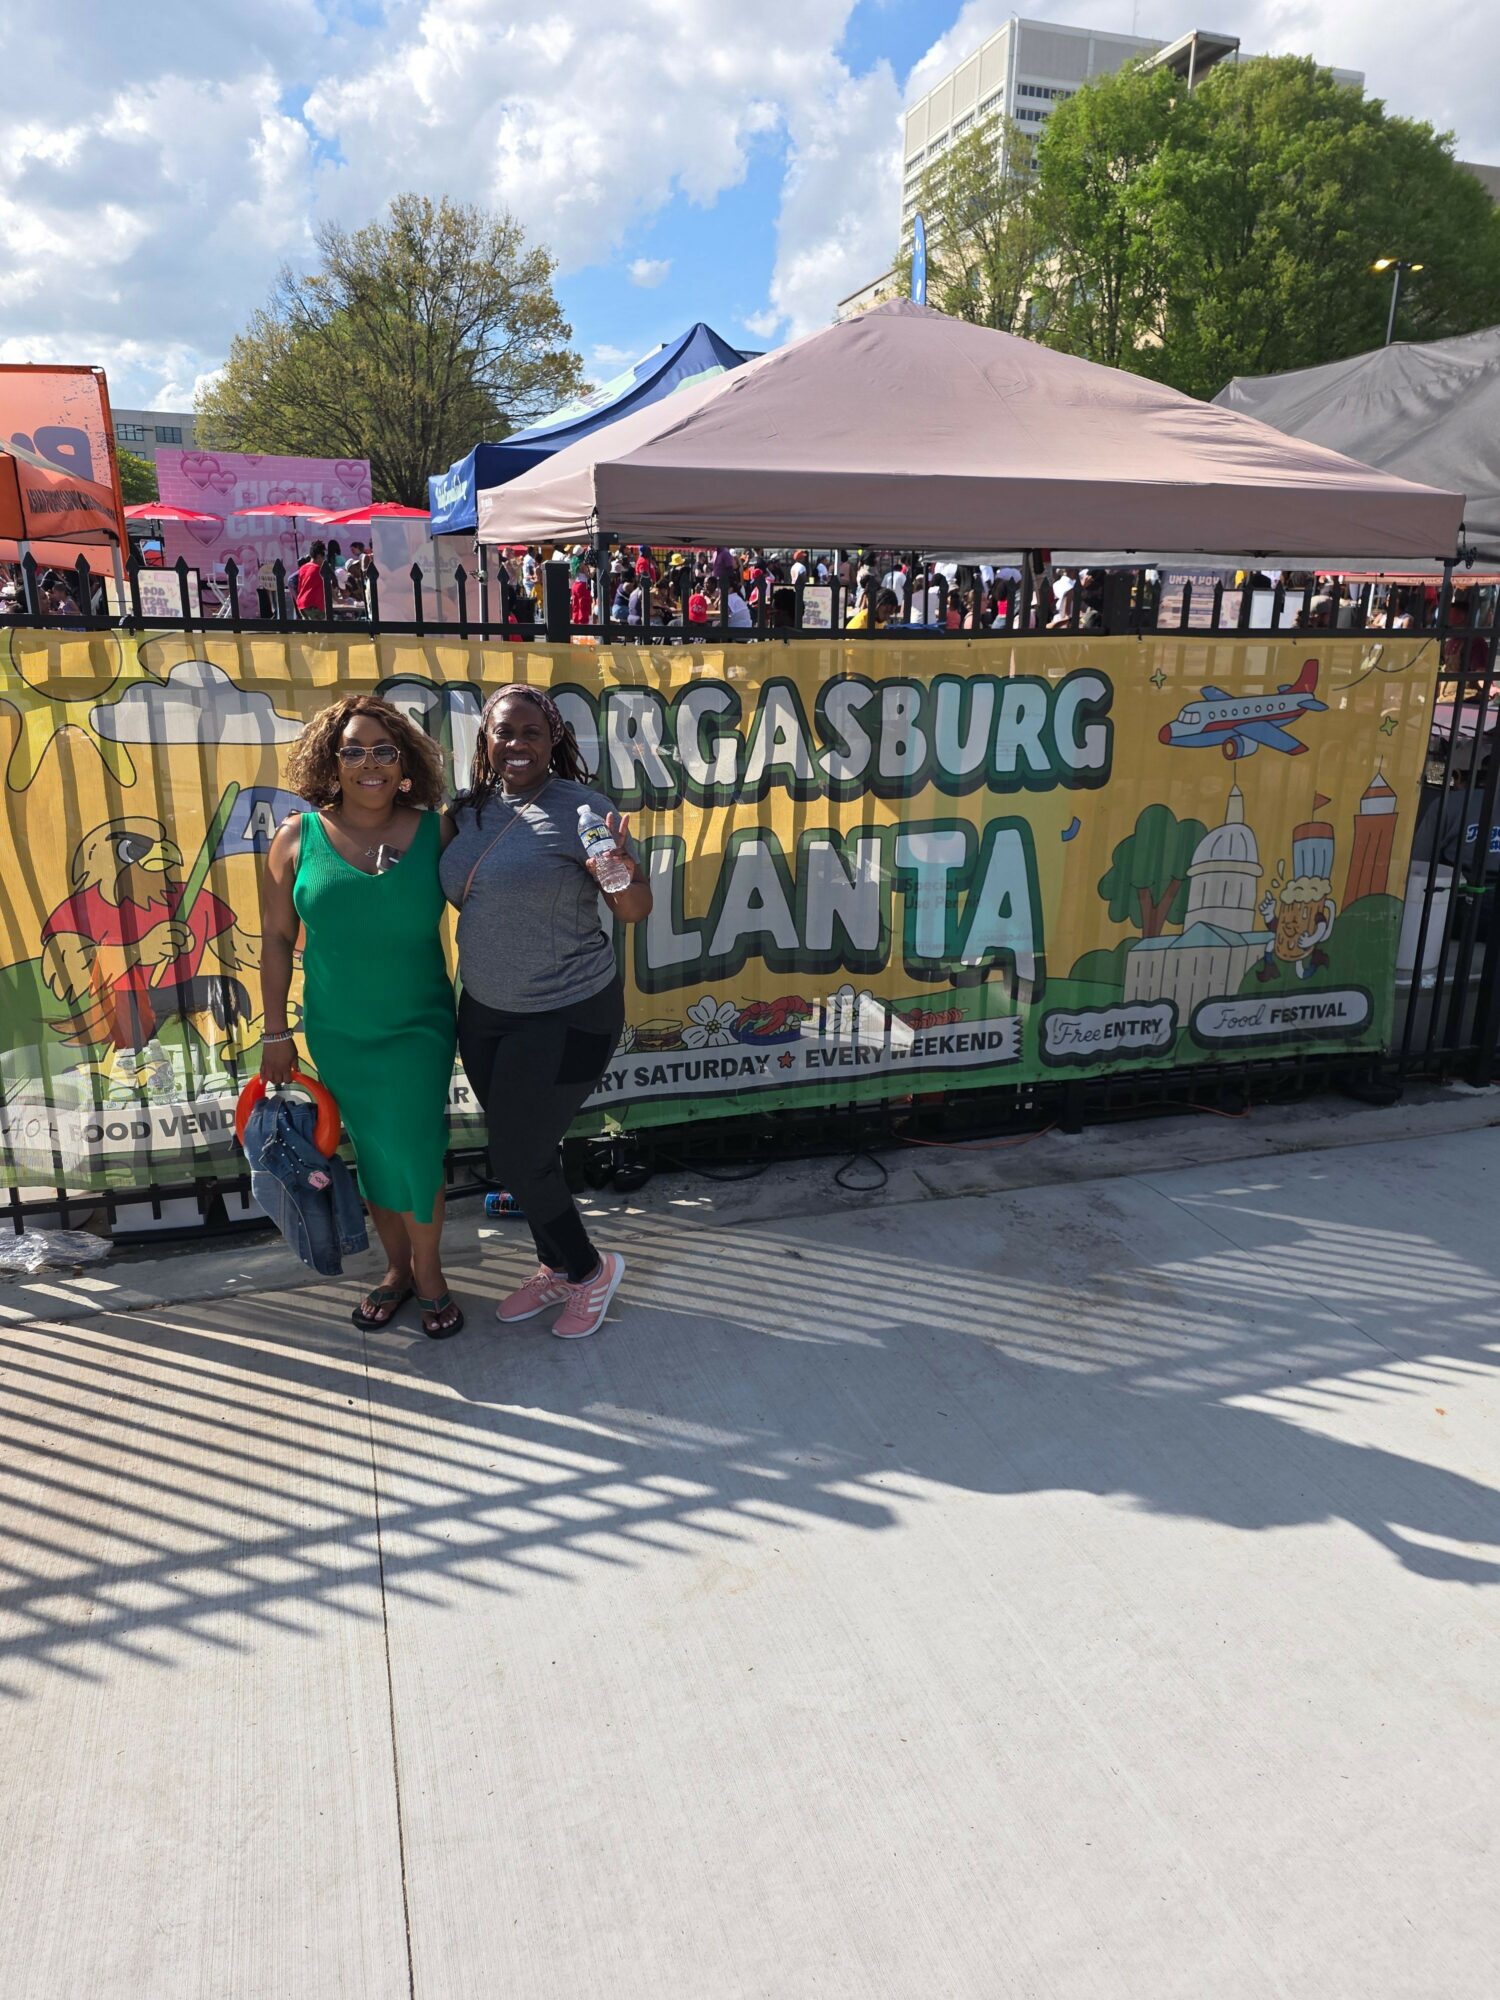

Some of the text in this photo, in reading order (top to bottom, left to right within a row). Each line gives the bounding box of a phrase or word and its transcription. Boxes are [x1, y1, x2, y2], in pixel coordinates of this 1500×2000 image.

[608, 815, 1046, 998] LANTA
[1053, 1018, 1163, 1045] Free ENTRY
[1213, 1002, 1348, 1030] Food FESTIVAL
[634, 1053, 770, 1083] SATURDAY
[805, 1045, 886, 1069] EVERY
[69, 1121, 151, 1144] FOOD
[159, 1108, 236, 1137] VEND
